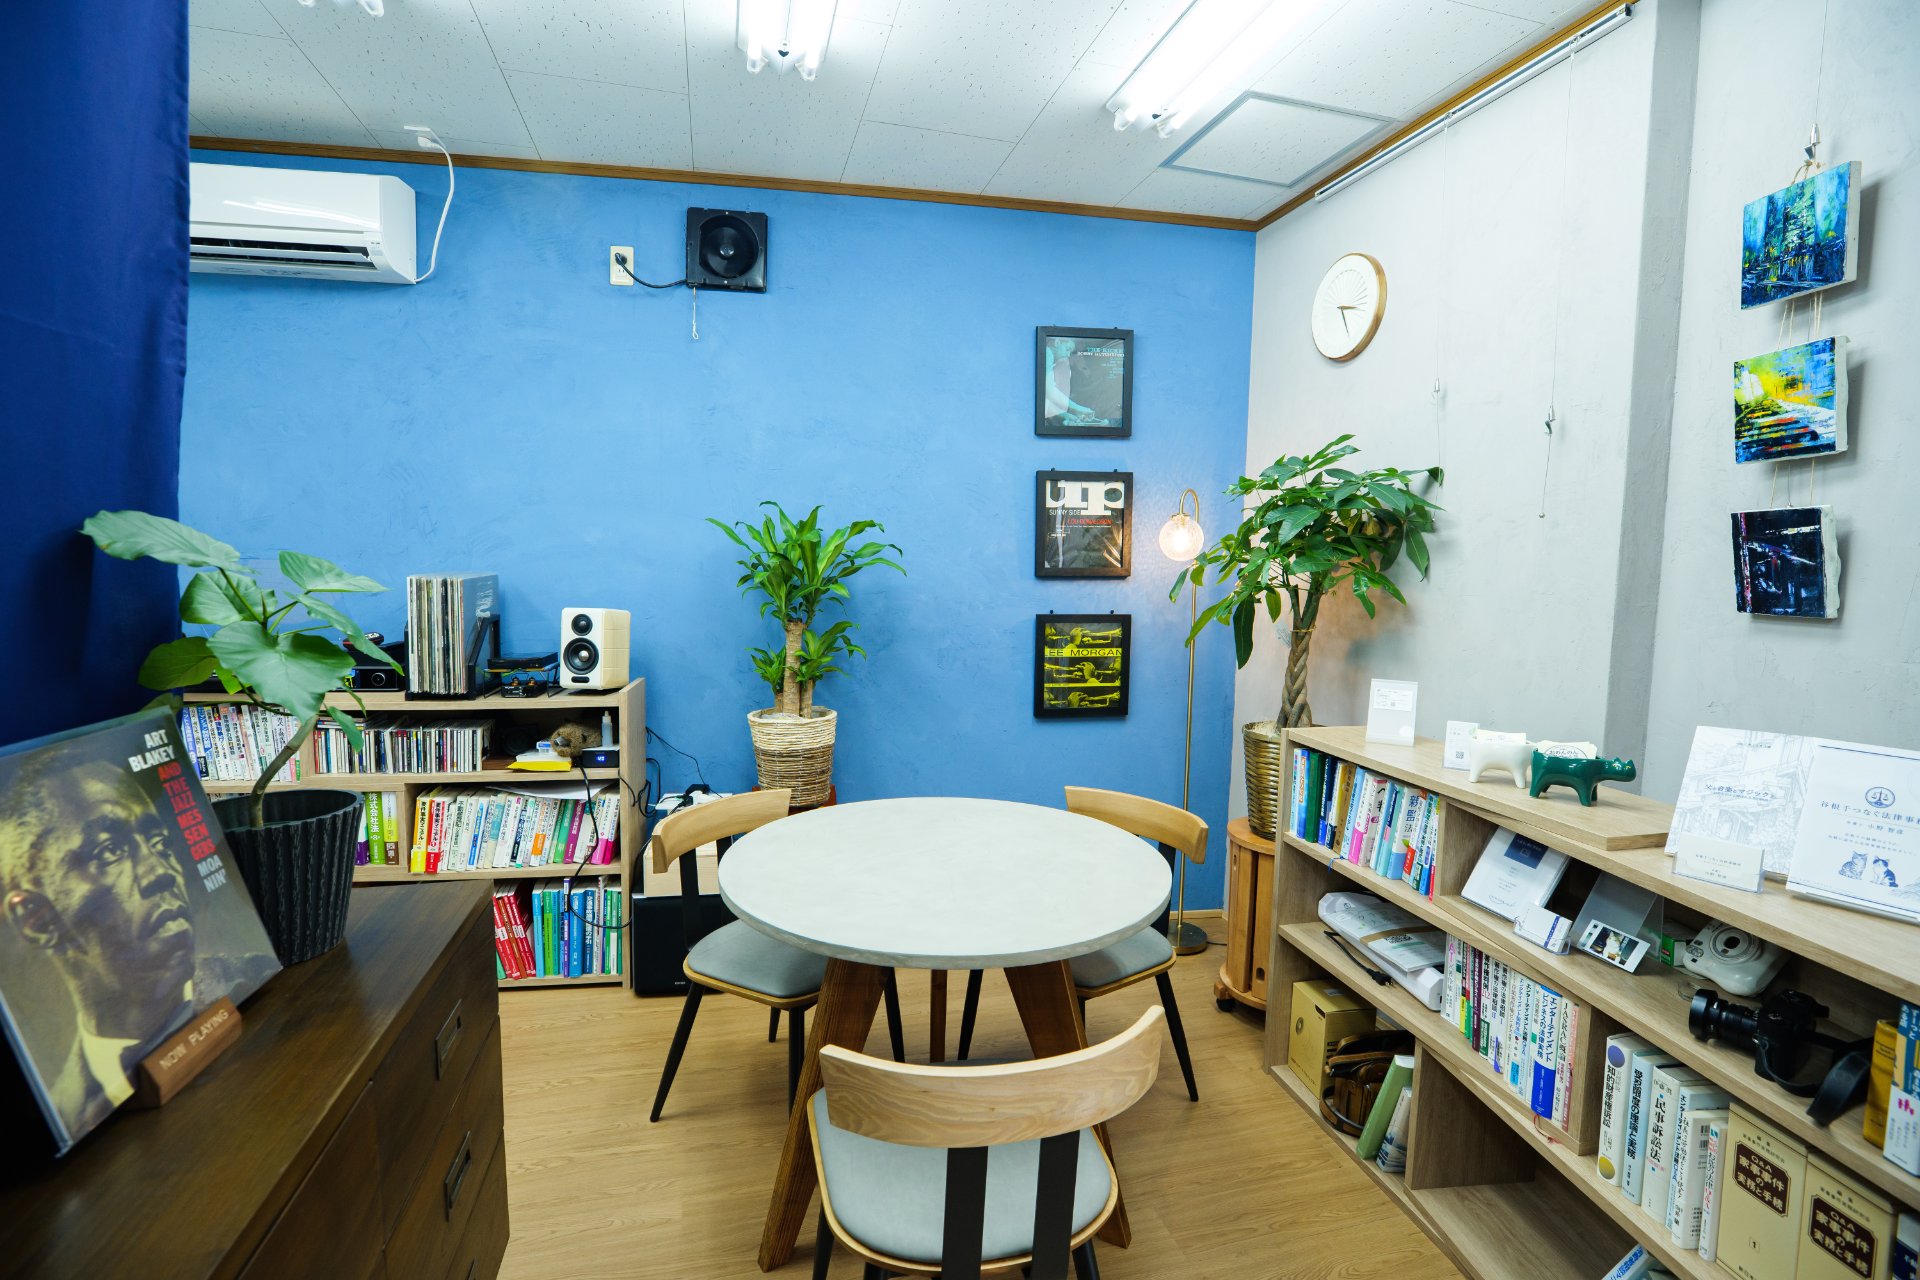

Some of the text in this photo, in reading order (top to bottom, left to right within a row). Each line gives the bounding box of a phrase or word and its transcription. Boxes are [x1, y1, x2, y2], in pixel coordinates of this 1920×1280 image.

[143, 729, 168, 750] ART
[128, 745, 176, 773] BLAKEY
[157, 761, 182, 781] AND
[163, 776, 190, 796] THE
[170, 793, 196, 814] JAZZ
[369, 793, 379, 833] 株式会社法
[176, 810, 203, 831] MES
[184, 824, 209, 847] SEN
[190, 838, 216, 862] GERS
[196, 856, 224, 877] MOA
[203, 870, 228, 893] NIN'
[159, 1008, 230, 1071] NOW PLAYING
[1545, 996, 1558, 1063] エンターテインメント
[1650, 1098, 1666, 1164] 民事訴訟法
[1739, 1154, 1785, 1191] 家事事件
[1751, 1155, 1772, 1173] Q&A
[1737, 1171, 1783, 1211] 実務と手続
[1755, 1177, 1764, 1186] の
[1815, 1209, 1870, 1254] 家事事件
[1830, 1211, 1856, 1233] Q&A
[1813, 1228, 1868, 1276] 実務と手続
[1836, 1236, 1846, 1246] の
